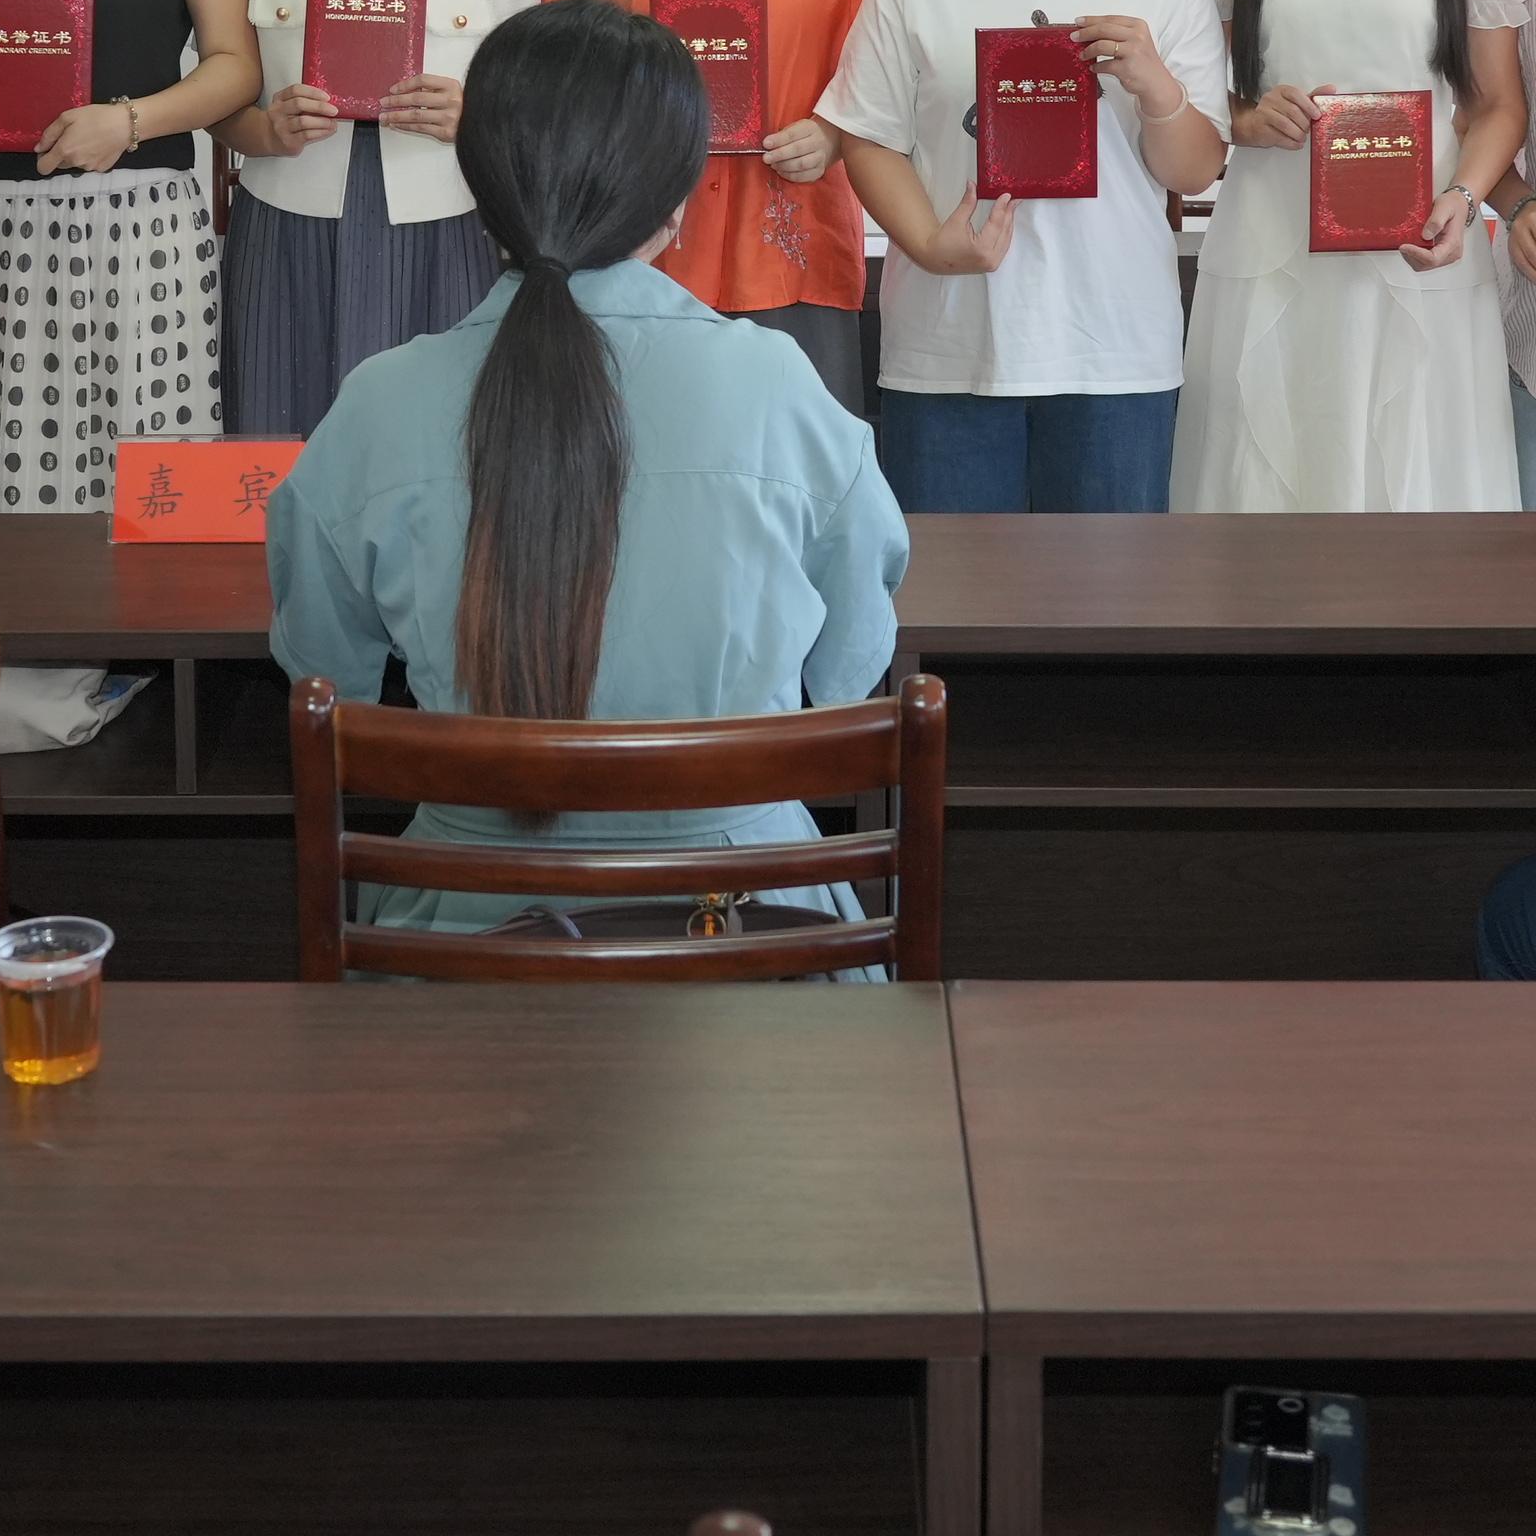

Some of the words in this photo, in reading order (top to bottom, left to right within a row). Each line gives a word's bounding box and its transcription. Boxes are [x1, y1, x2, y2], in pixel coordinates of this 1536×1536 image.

[325, 13, 363, 21] HONORARY
[363, 15, 406, 23] CREDENTIAL
[28, 47, 72, 55] CREDENTIAL
[679, 37, 748, 52] 誉证书
[997, 79, 1077, 94] 荣誉证书
[1330, 135, 1413, 151] 荣誉证书
[1330, 152, 1369, 160] HONORARY
[1369, 150, 1413, 158] CREDENTIAL
[137, 463, 277, 520] 嘉宾
